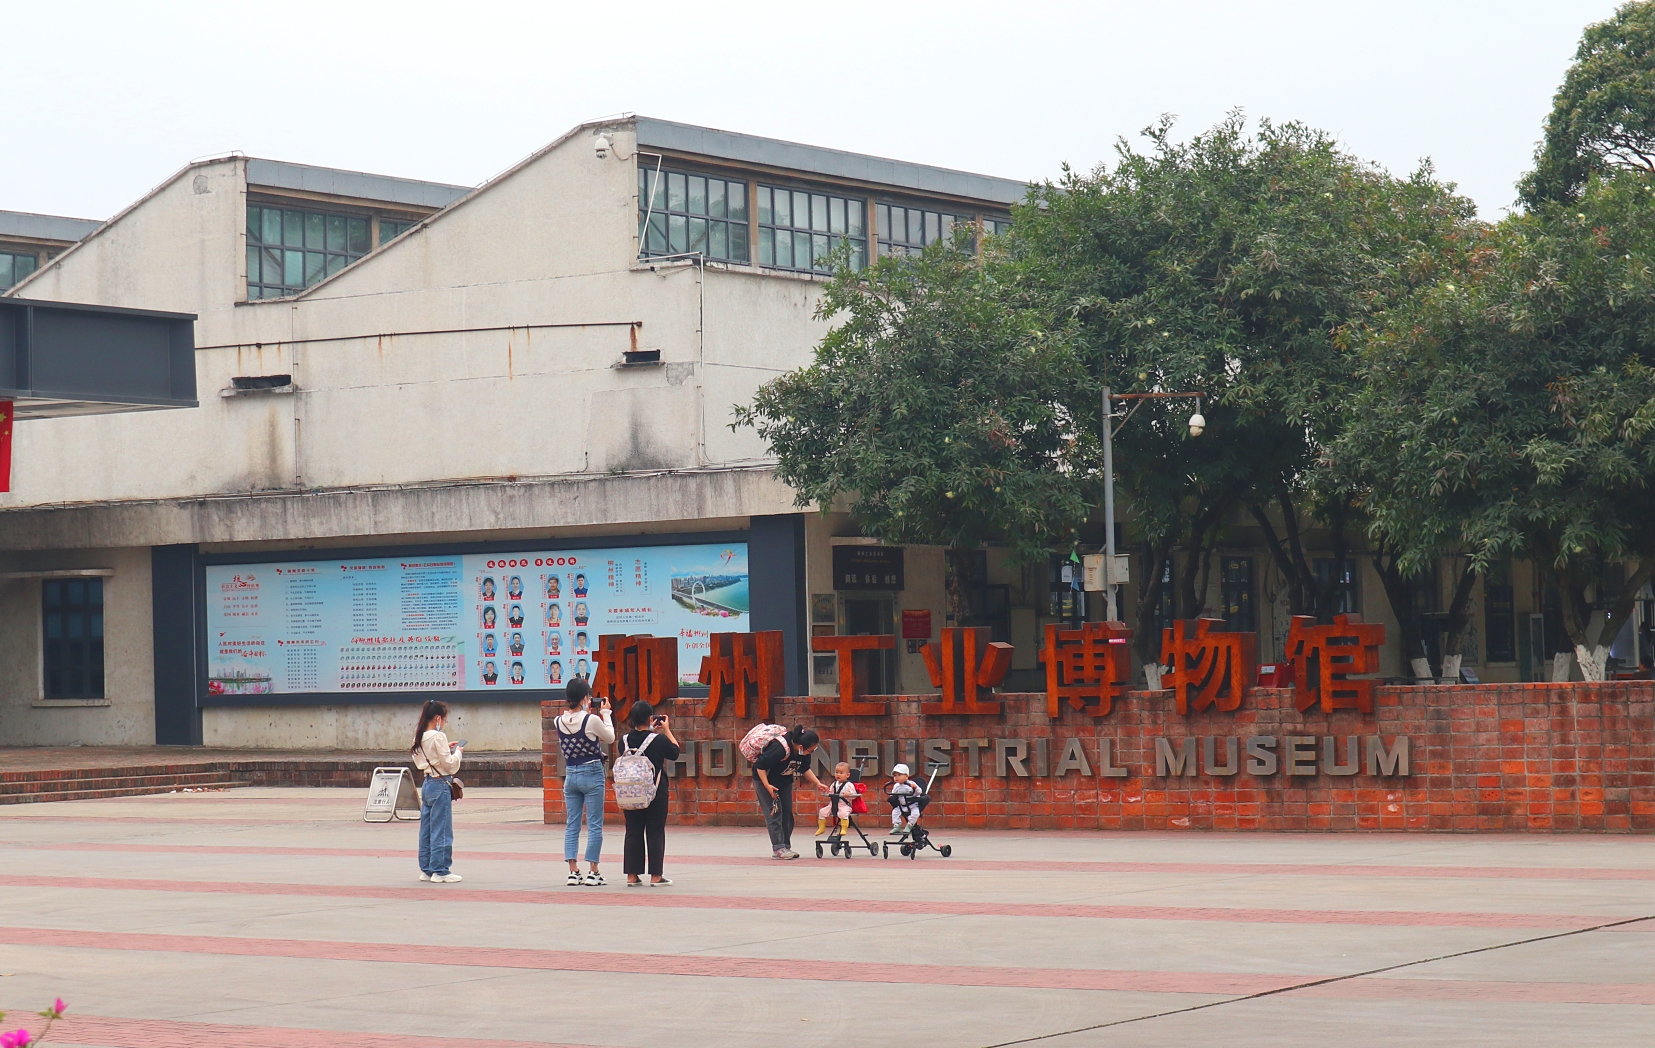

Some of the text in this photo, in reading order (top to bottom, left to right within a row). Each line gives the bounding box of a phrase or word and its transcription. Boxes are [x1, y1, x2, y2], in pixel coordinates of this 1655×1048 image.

[607, 560, 615, 587] 柳州精神
[591, 613, 1386, 723] 柳州工业博物馆
[790, 736, 1128, 779] NDUSTRIAL
[1154, 735, 1410, 777] MUSEUM
